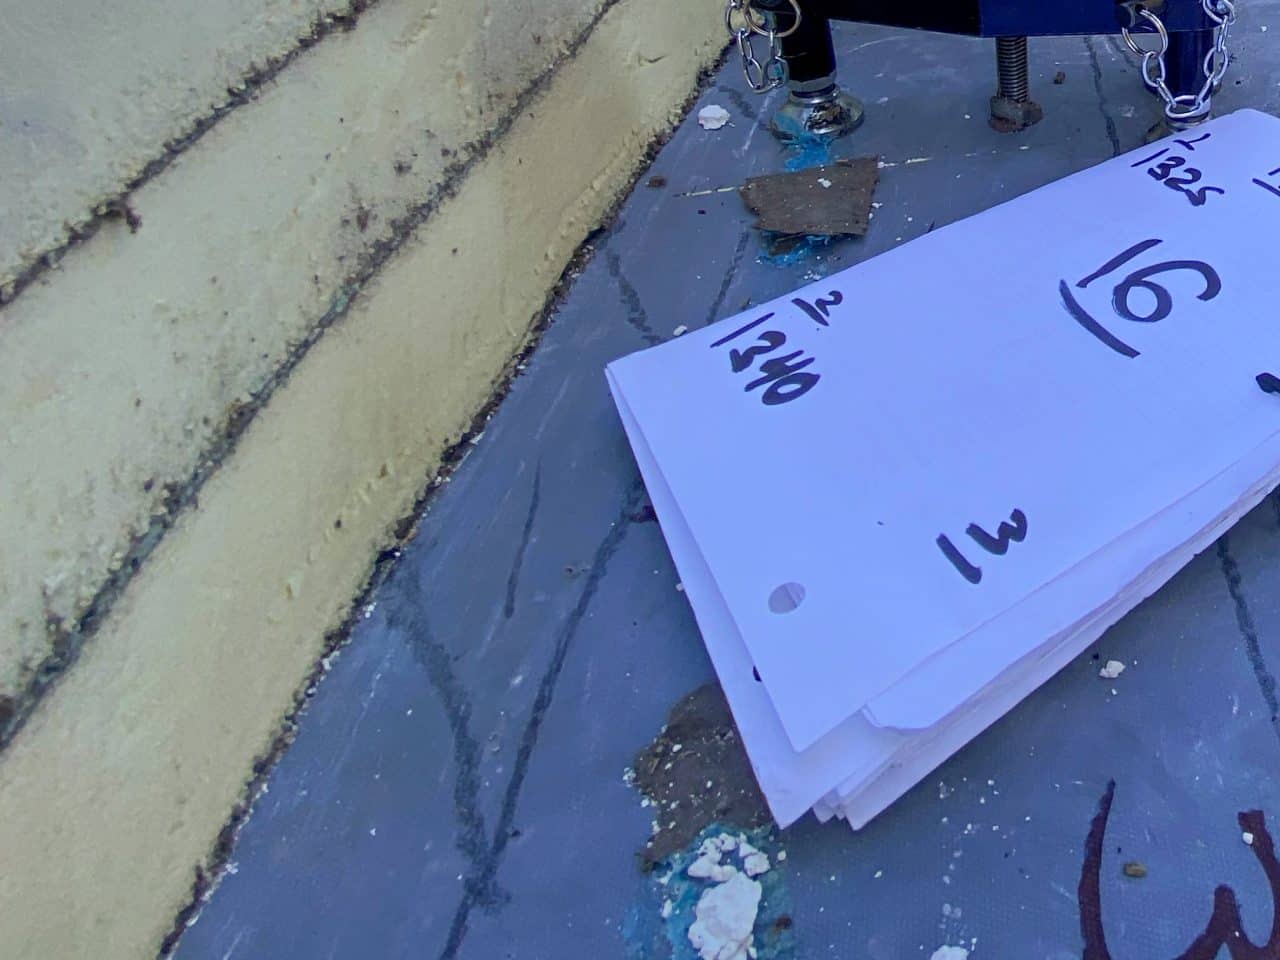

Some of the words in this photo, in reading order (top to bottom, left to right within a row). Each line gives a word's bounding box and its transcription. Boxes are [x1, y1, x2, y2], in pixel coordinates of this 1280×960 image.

[1130, 147, 1226, 208] 1325
[1076, 237, 1222, 323] 16
[709, 312, 822, 406] 1340
